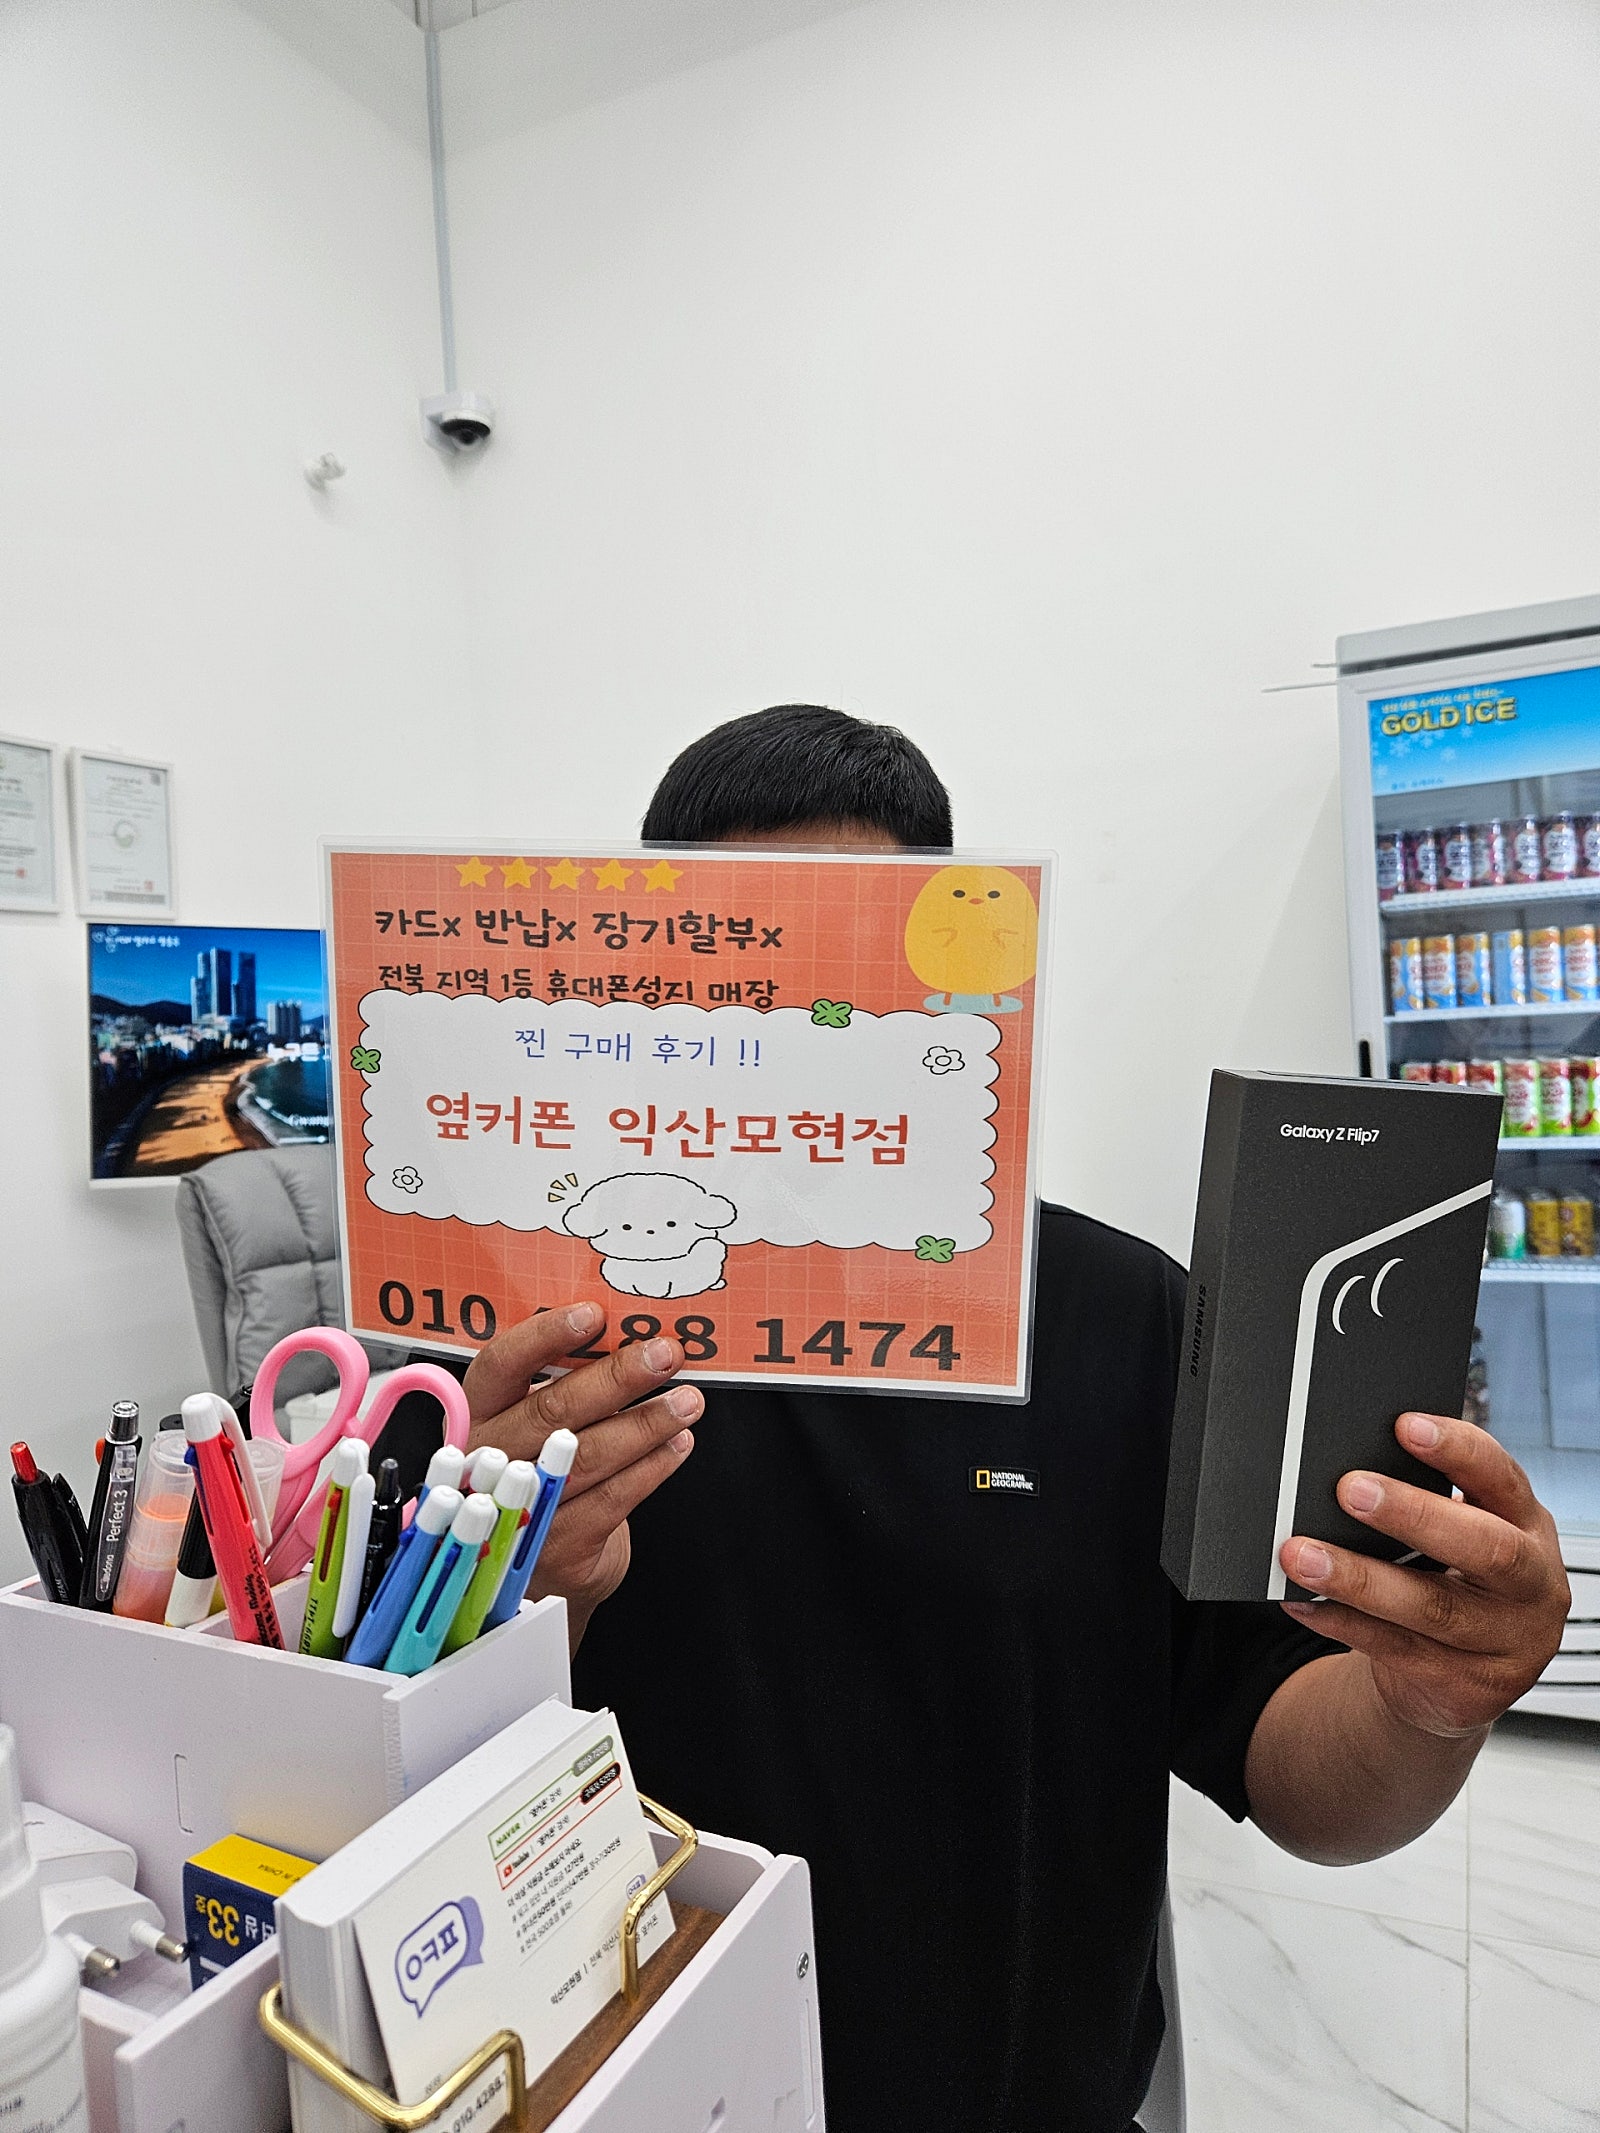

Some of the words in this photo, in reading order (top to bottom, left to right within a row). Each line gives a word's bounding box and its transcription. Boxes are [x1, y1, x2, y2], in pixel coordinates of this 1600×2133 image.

[1381, 705, 1461, 736] GOLD
[1465, 697, 1517, 724] ICE
[377, 963, 425, 991] 전북
[436, 968, 489, 995] 지역
[501, 968, 534, 998] 1등
[548, 968, 694, 1005] 휴대폰성지
[708, 979, 779, 1009] 매장
[514, 1029, 546, 1060] 찐
[564, 1033, 632, 1064] 구매
[653, 1036, 716, 1068] 후기
[738, 1039, 761, 1067] !!
[426, 1092, 576, 1150] 옆커폰
[608, 1104, 909, 1166] 익산모현점
[1280, 1123, 1335, 1143] Galaxy
[1335, 1127, 1346, 1140] Z
[1347, 1127, 1380, 1146] Flip7
[378, 1280, 497, 1342] 010
[754, 1318, 961, 1371] 1474
[1190, 1284, 1207, 1377] SAMSUNG
[114, 1489, 128, 1498] 3
[991, 1471, 1026, 1482] NATIONAL
[991, 1479, 1034, 1491] GEOGRAPHIC
[106, 1501, 126, 1542] Perfect
[496, 1821, 520, 1846] NAVER
[550, 1968, 581, 2008] 익산모현점
